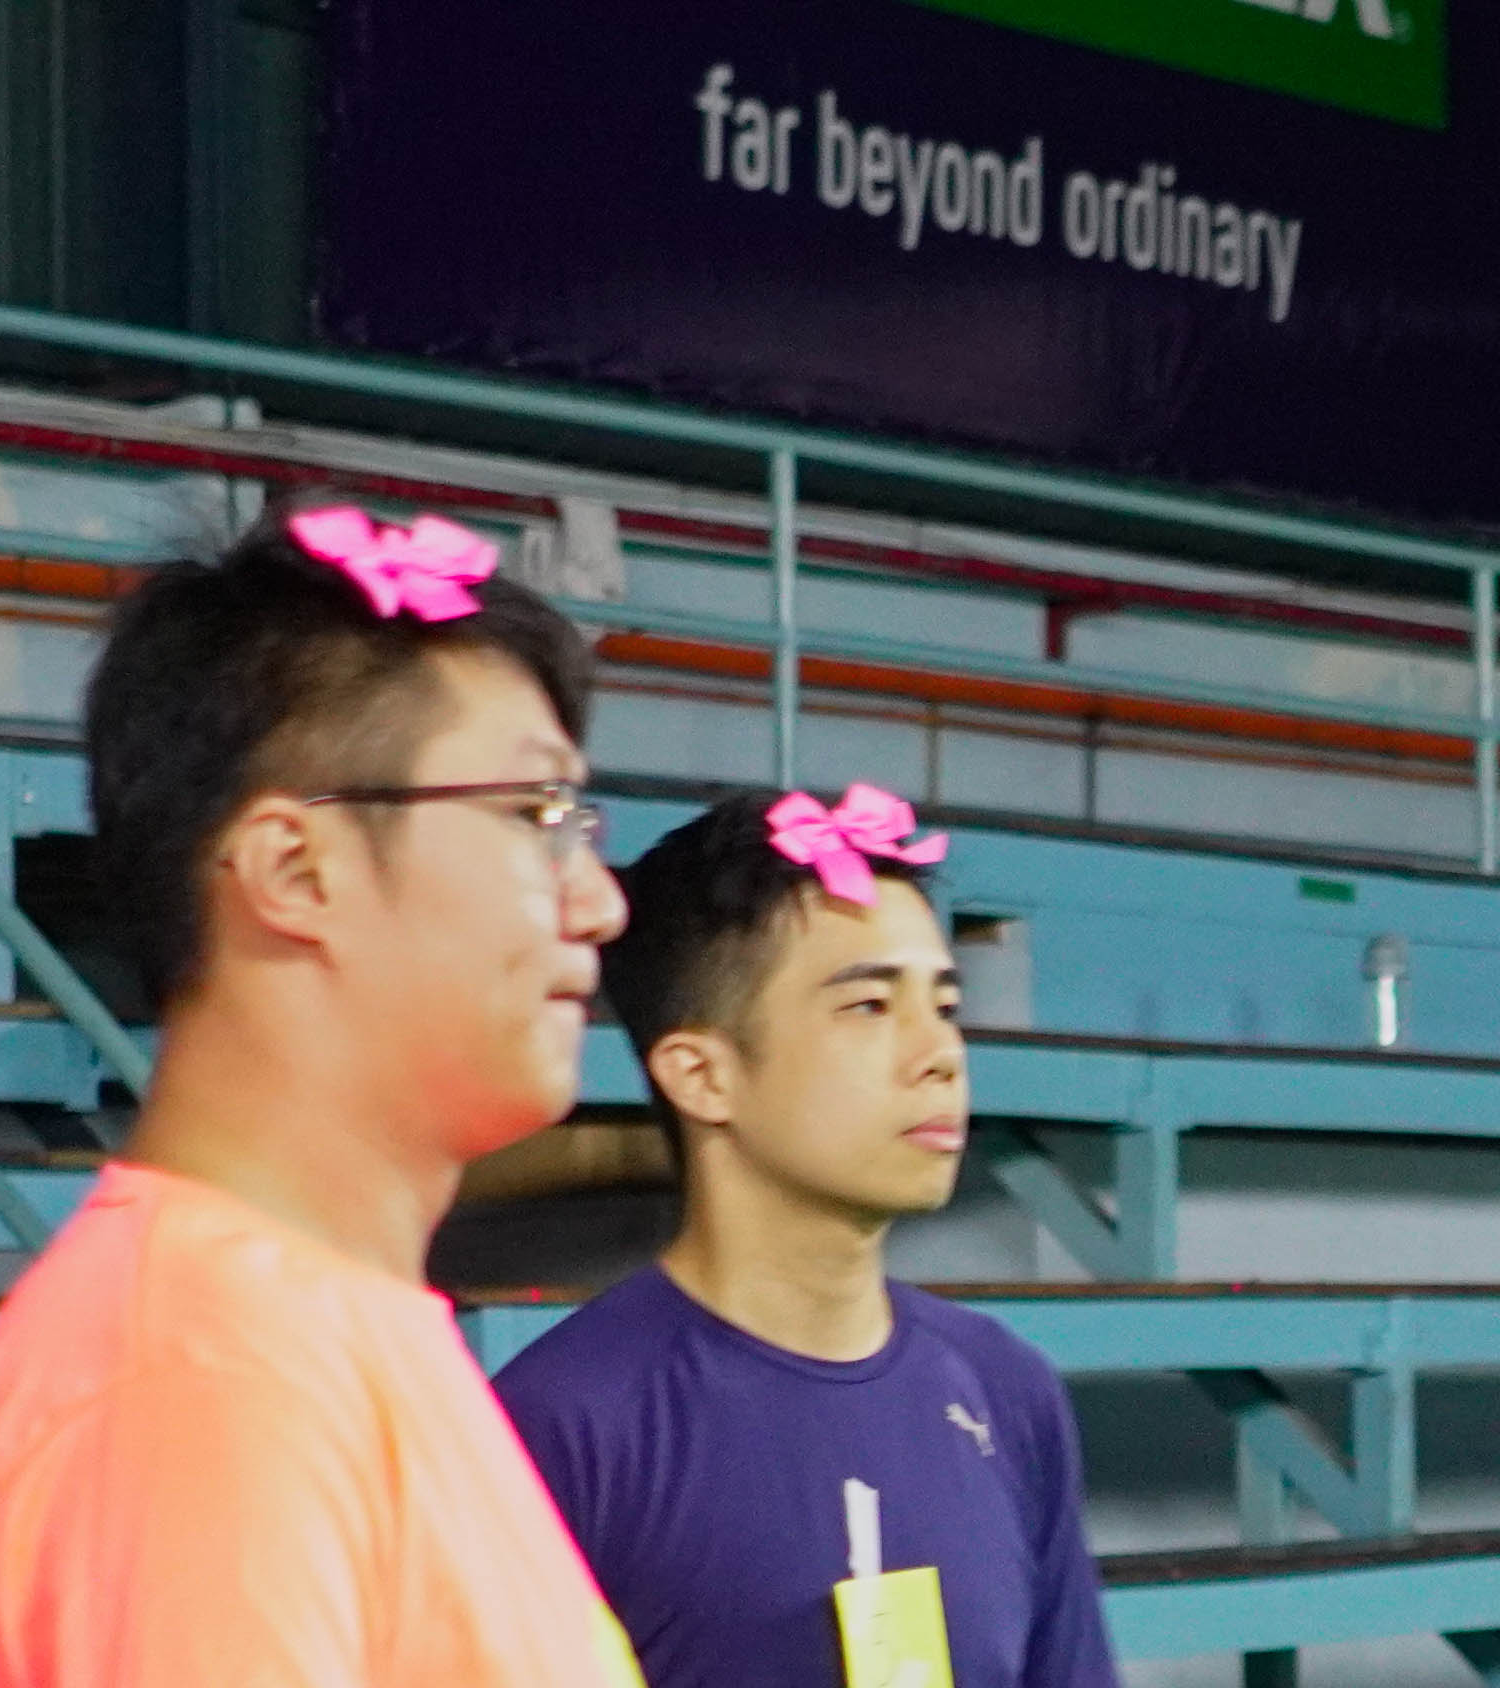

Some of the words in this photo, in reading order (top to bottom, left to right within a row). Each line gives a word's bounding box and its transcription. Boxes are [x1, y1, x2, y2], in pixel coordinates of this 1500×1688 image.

[695, 63, 801, 195] far
[817, 89, 1044, 251] beyond
[1063, 164, 1302, 323] ordinary
